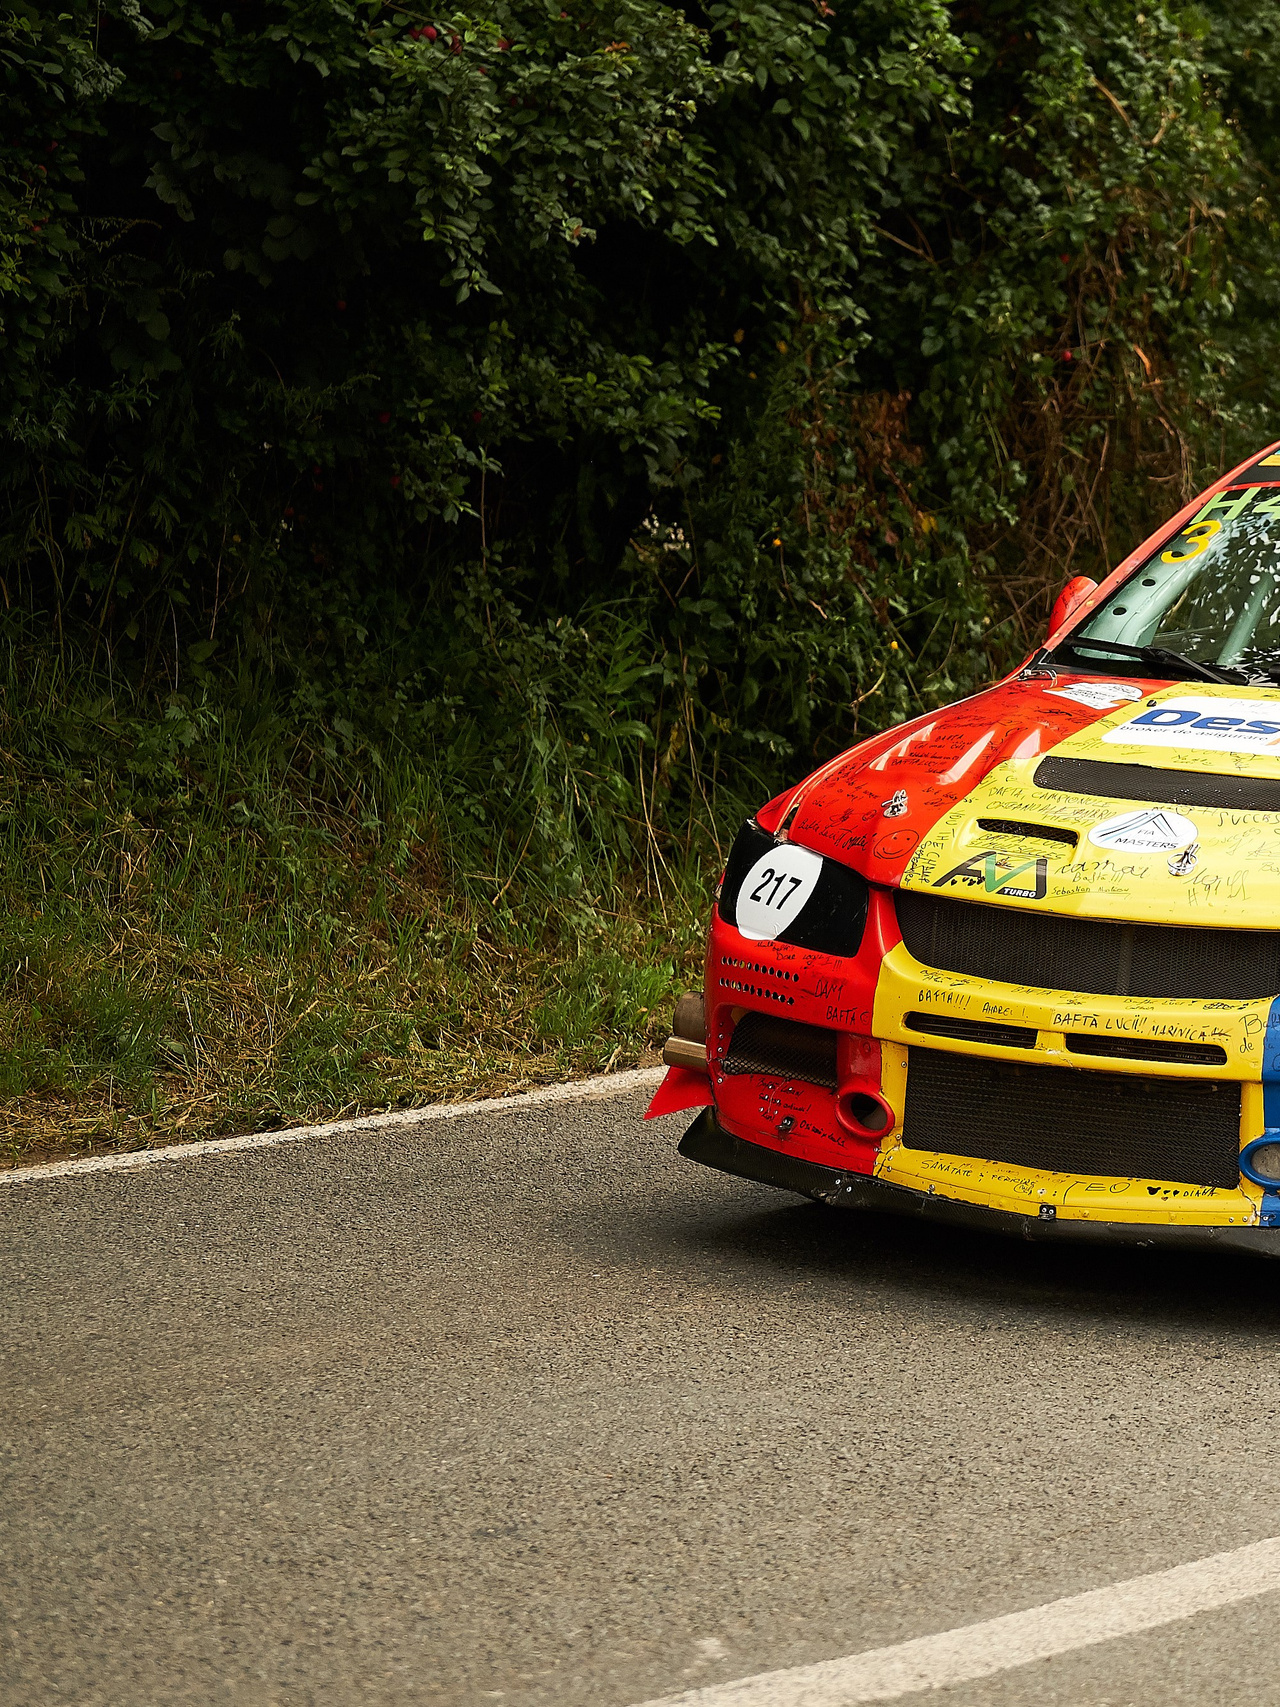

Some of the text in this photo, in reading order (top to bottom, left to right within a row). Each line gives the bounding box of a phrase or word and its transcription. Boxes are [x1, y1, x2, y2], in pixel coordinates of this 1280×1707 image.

[1161, 520, 1221, 564] 3
[1115, 837, 1178, 849] MASTERS
[749, 868, 803, 911] 217
[1003, 887, 1037, 898] TURBO
